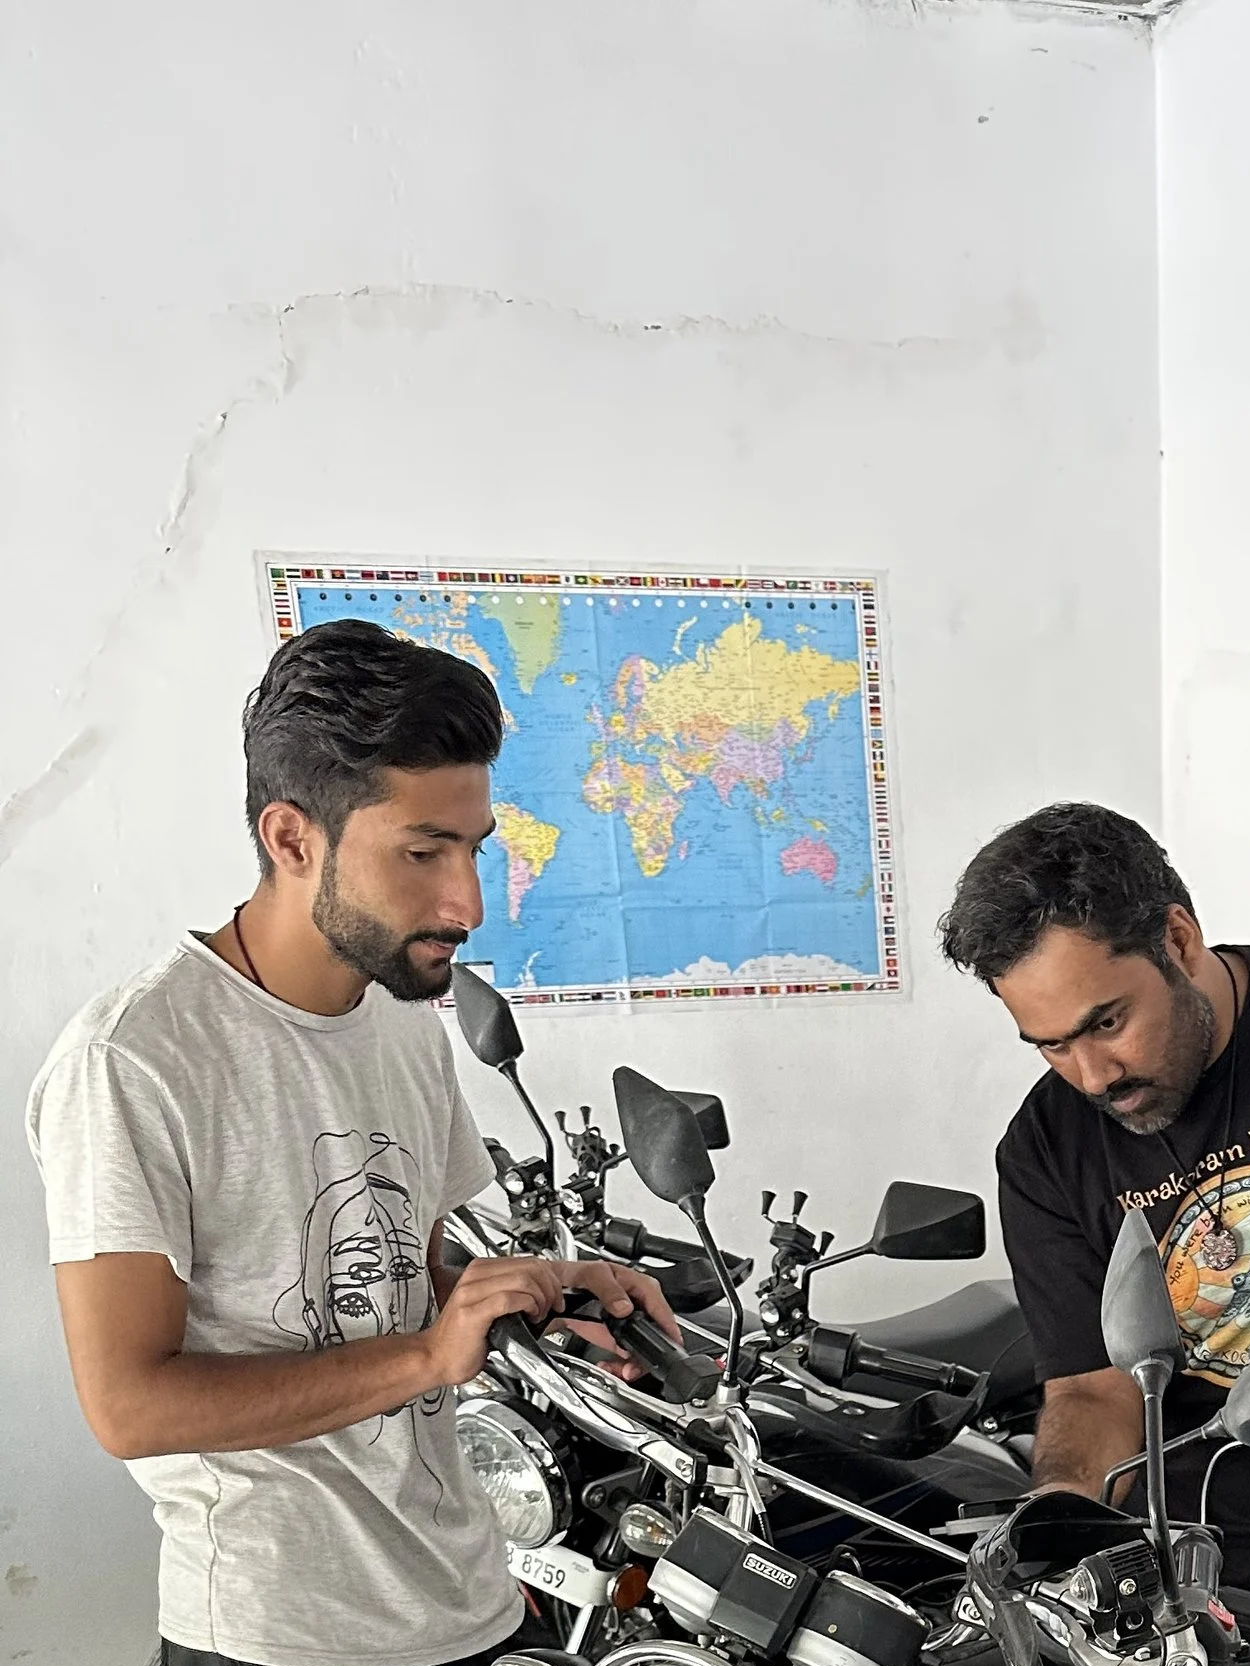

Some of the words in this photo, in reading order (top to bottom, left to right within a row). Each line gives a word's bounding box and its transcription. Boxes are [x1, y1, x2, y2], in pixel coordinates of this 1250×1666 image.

[1170, 1261, 1184, 1285] You
[1200, 1205, 1232, 1228] bn
[522, 1554, 566, 1588] 8759
[746, 1558, 794, 1586] SUZUKI
